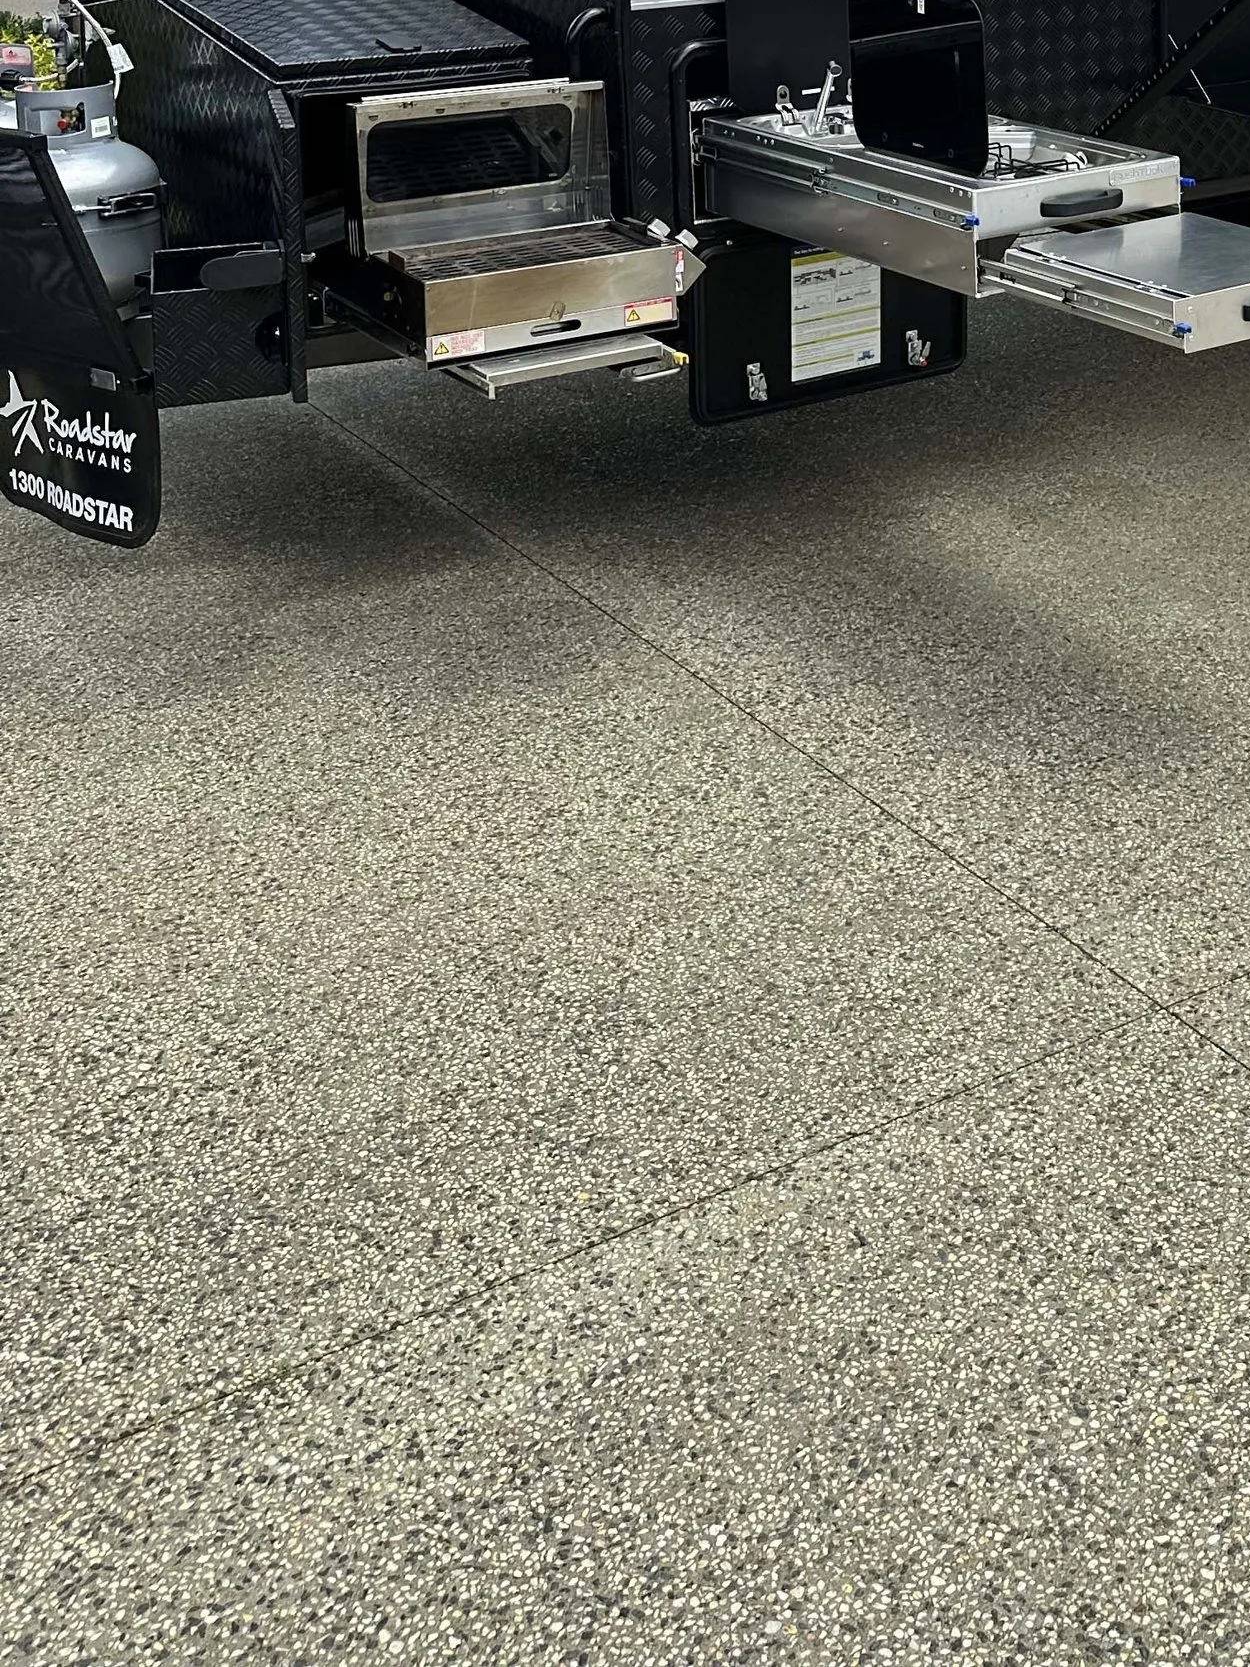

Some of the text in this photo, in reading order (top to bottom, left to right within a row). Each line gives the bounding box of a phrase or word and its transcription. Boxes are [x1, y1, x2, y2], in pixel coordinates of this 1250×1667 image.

[41, 399, 137, 453] Roadstar
[48, 437, 132, 474] CARAVANS
[9, 468, 134, 532] 1300 ROADSTAR
